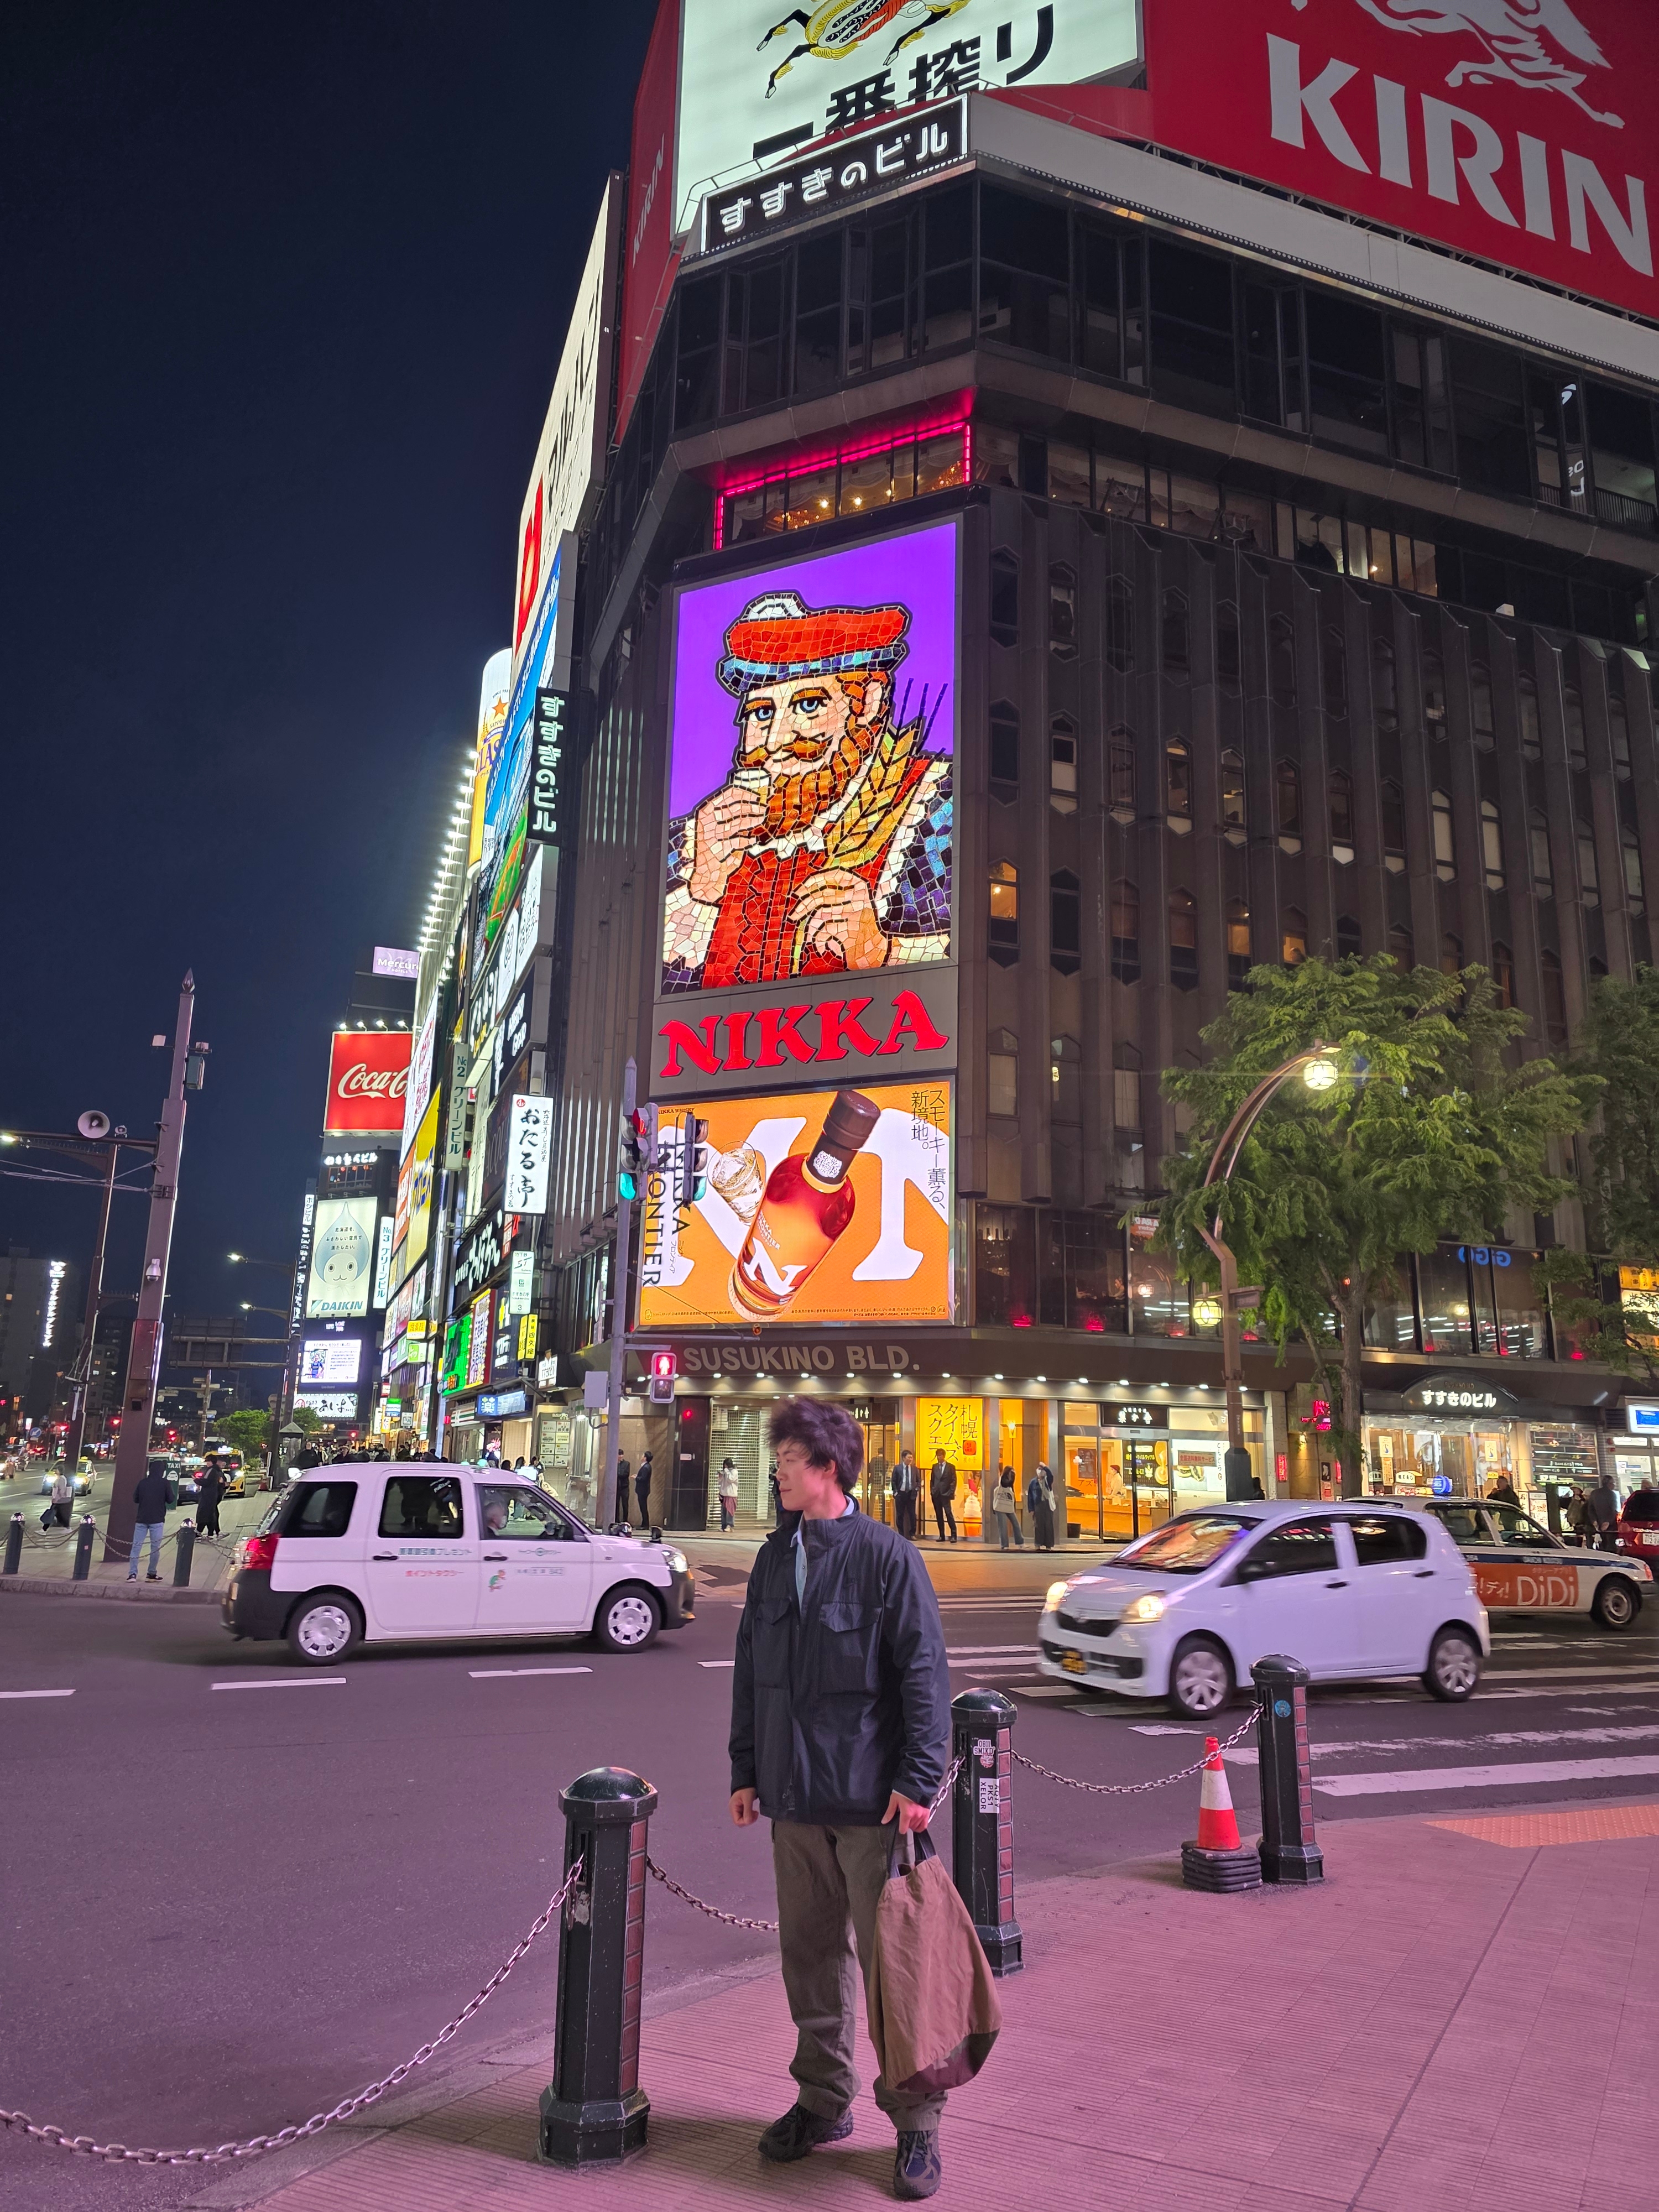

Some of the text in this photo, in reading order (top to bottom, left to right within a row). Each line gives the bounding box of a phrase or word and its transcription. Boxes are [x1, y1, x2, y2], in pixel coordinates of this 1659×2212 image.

[753, 3, 1054, 159] 一番搾り
[719, 123, 949, 236] すすきのビル
[1266, 32, 1654, 278] KIRIN
[533, 696, 566, 833] すすきのビル
[658, 990, 950, 1078] NIKKA
[457, 1067, 466, 1077] 2
[448, 1086, 467, 1155] グリーンビル
[911, 1089, 930, 1150] 新境地。
[517, 1108, 541, 1208] おたる亭
[927, 1089, 947, 1210] スモーキー薫る、
[643, 1147, 666, 1287] FONTIER
[377, 1247, 390, 1298] グリーンビル
[321, 1301, 363, 1311] DAIKIN
[527, 1332, 535, 1355] 四文屋
[684, 1345, 920, 1371] SUSUKINO BLD.
[960, 1405, 978, 1438] 札幌
[1422, 1390, 1497, 1408] すすきのビル
[944, 1404, 962, 1462] タイムズ
[1180, 1454, 1215, 1463] 全国送料無料サービス
[1517, 1576, 1575, 1606] DiDi
